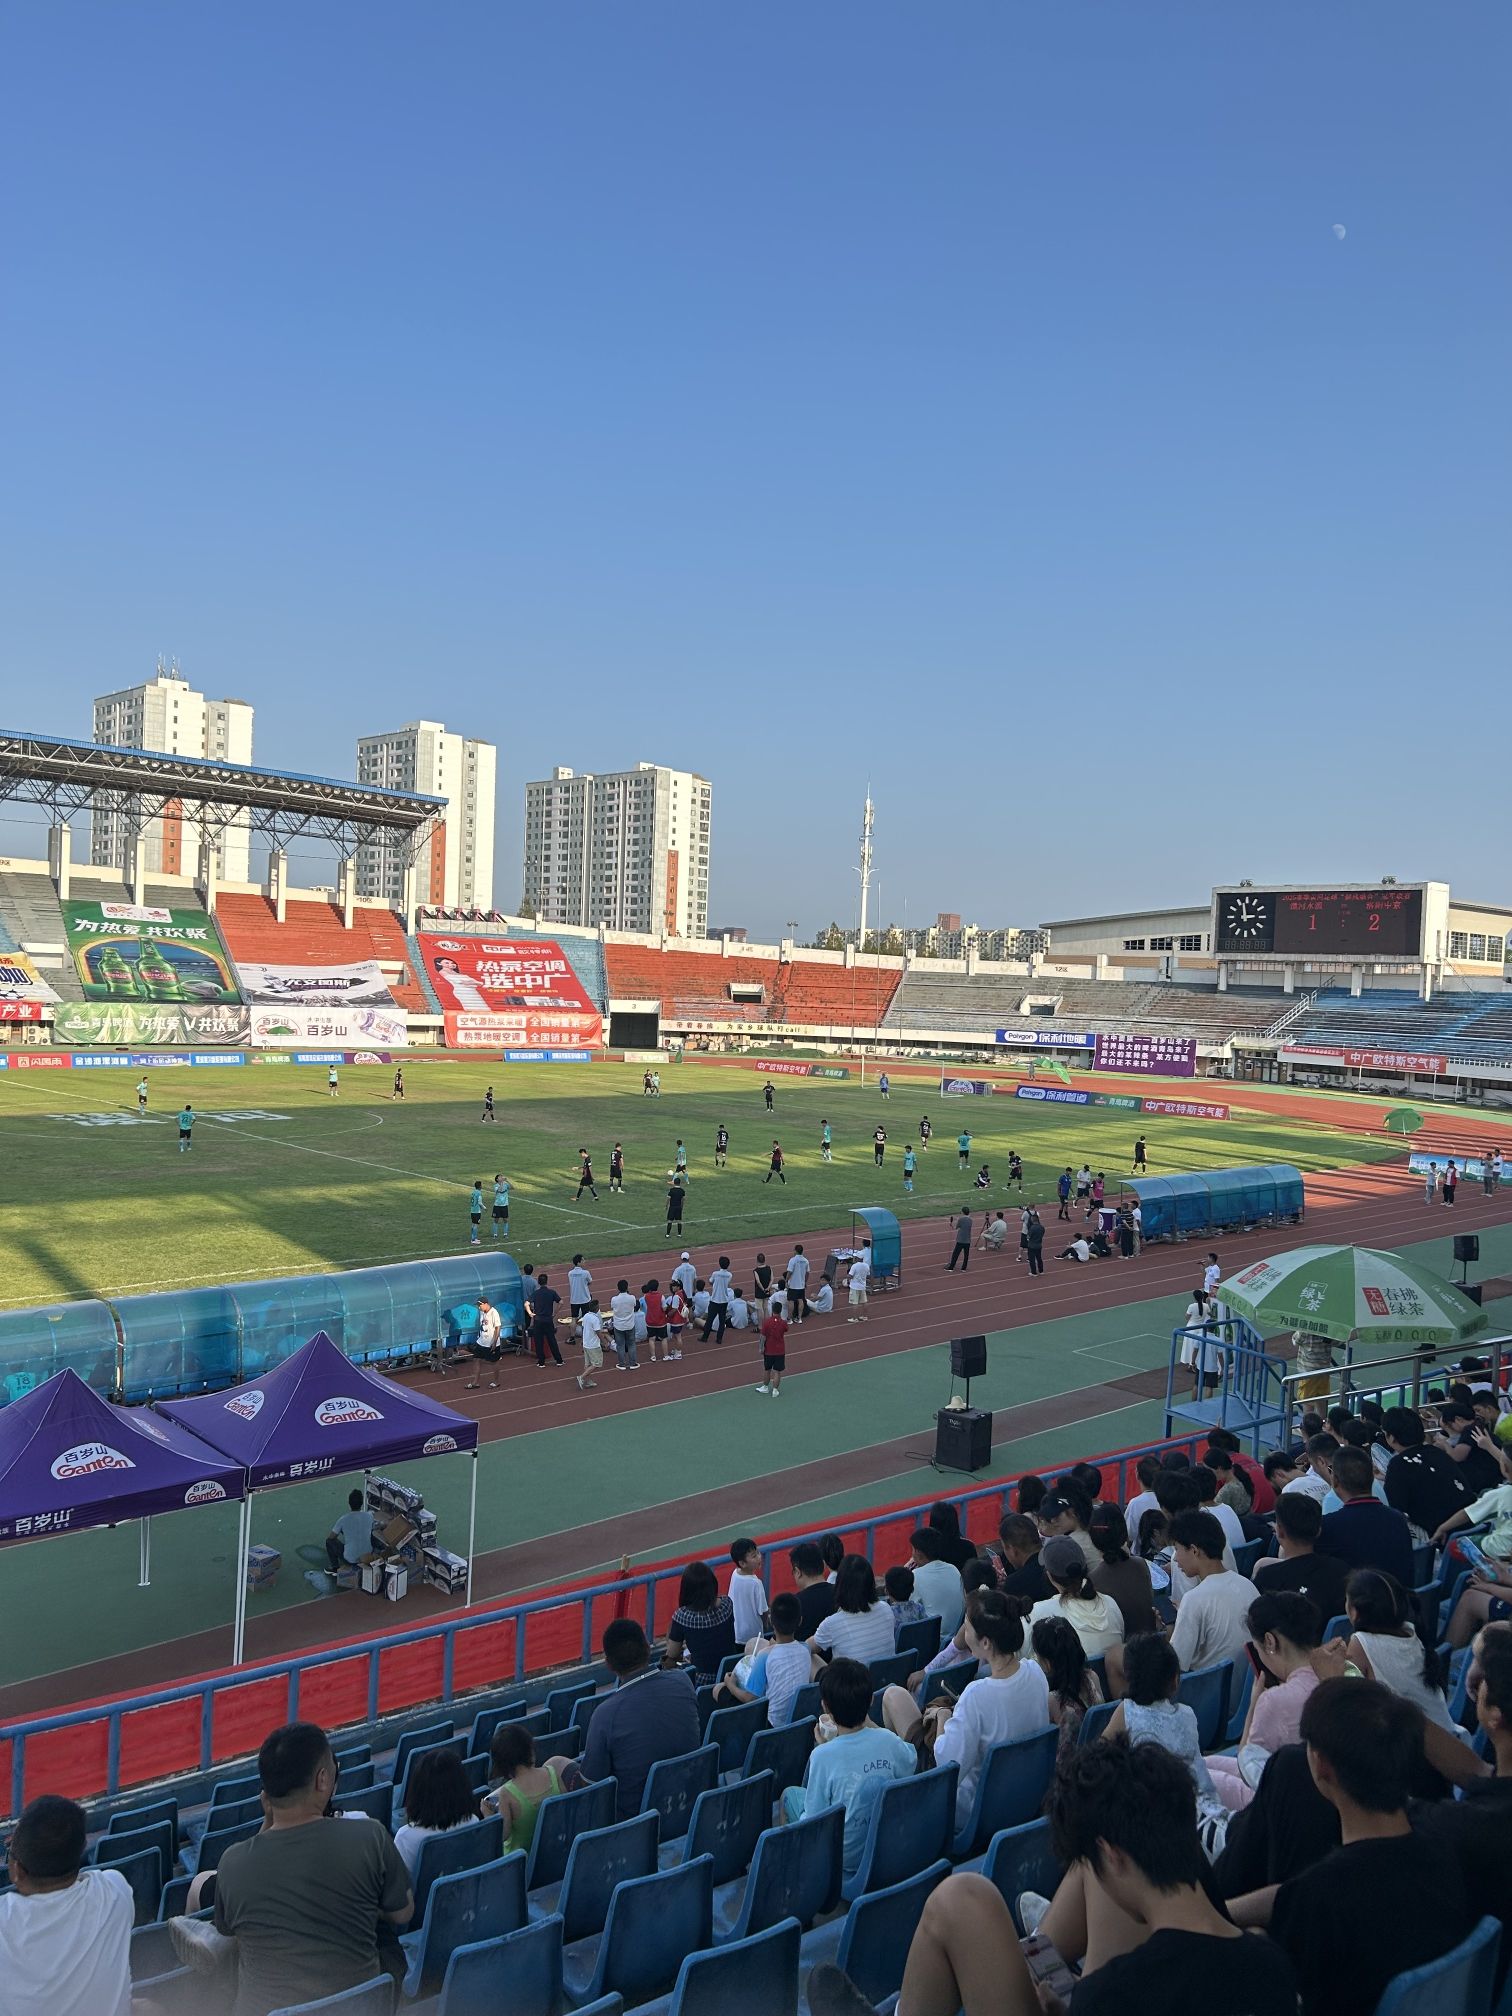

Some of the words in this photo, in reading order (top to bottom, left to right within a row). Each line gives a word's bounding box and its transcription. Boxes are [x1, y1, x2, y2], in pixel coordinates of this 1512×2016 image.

[74, 918, 141, 935] 为热爱
[146, 926, 209, 940] 共欢聚
[1308, 914, 1317, 930] 1
[1368, 913, 1380, 931] 2
[475, 960, 567, 973] 热泵空调
[480, 972, 571, 989] 选中广
[1, 1004, 33, 1018] 产业
[262, 1018, 289, 1026] 百岁山
[307, 1025, 348, 1036] 百岁山
[530, 1032, 592, 1044] 全国销量第一
[1038, 1033, 1087, 1045] 保利地暖
[1350, 1051, 1440, 1070] 中广欧特斯空气能
[1145, 1100, 1225, 1118] 中广欧特斯空气能
[1388, 1301, 1424, 1316] 绿茶
[324, 1400, 360, 1411] 百岁山
[319, 1408, 379, 1424] Ganten
[64, 1445, 108, 1463] 百岁山
[56, 1455, 128, 1477] Ganten
[290, 1457, 334, 1478] 百岁山
[15, 1509, 71, 1533] 百岁山
